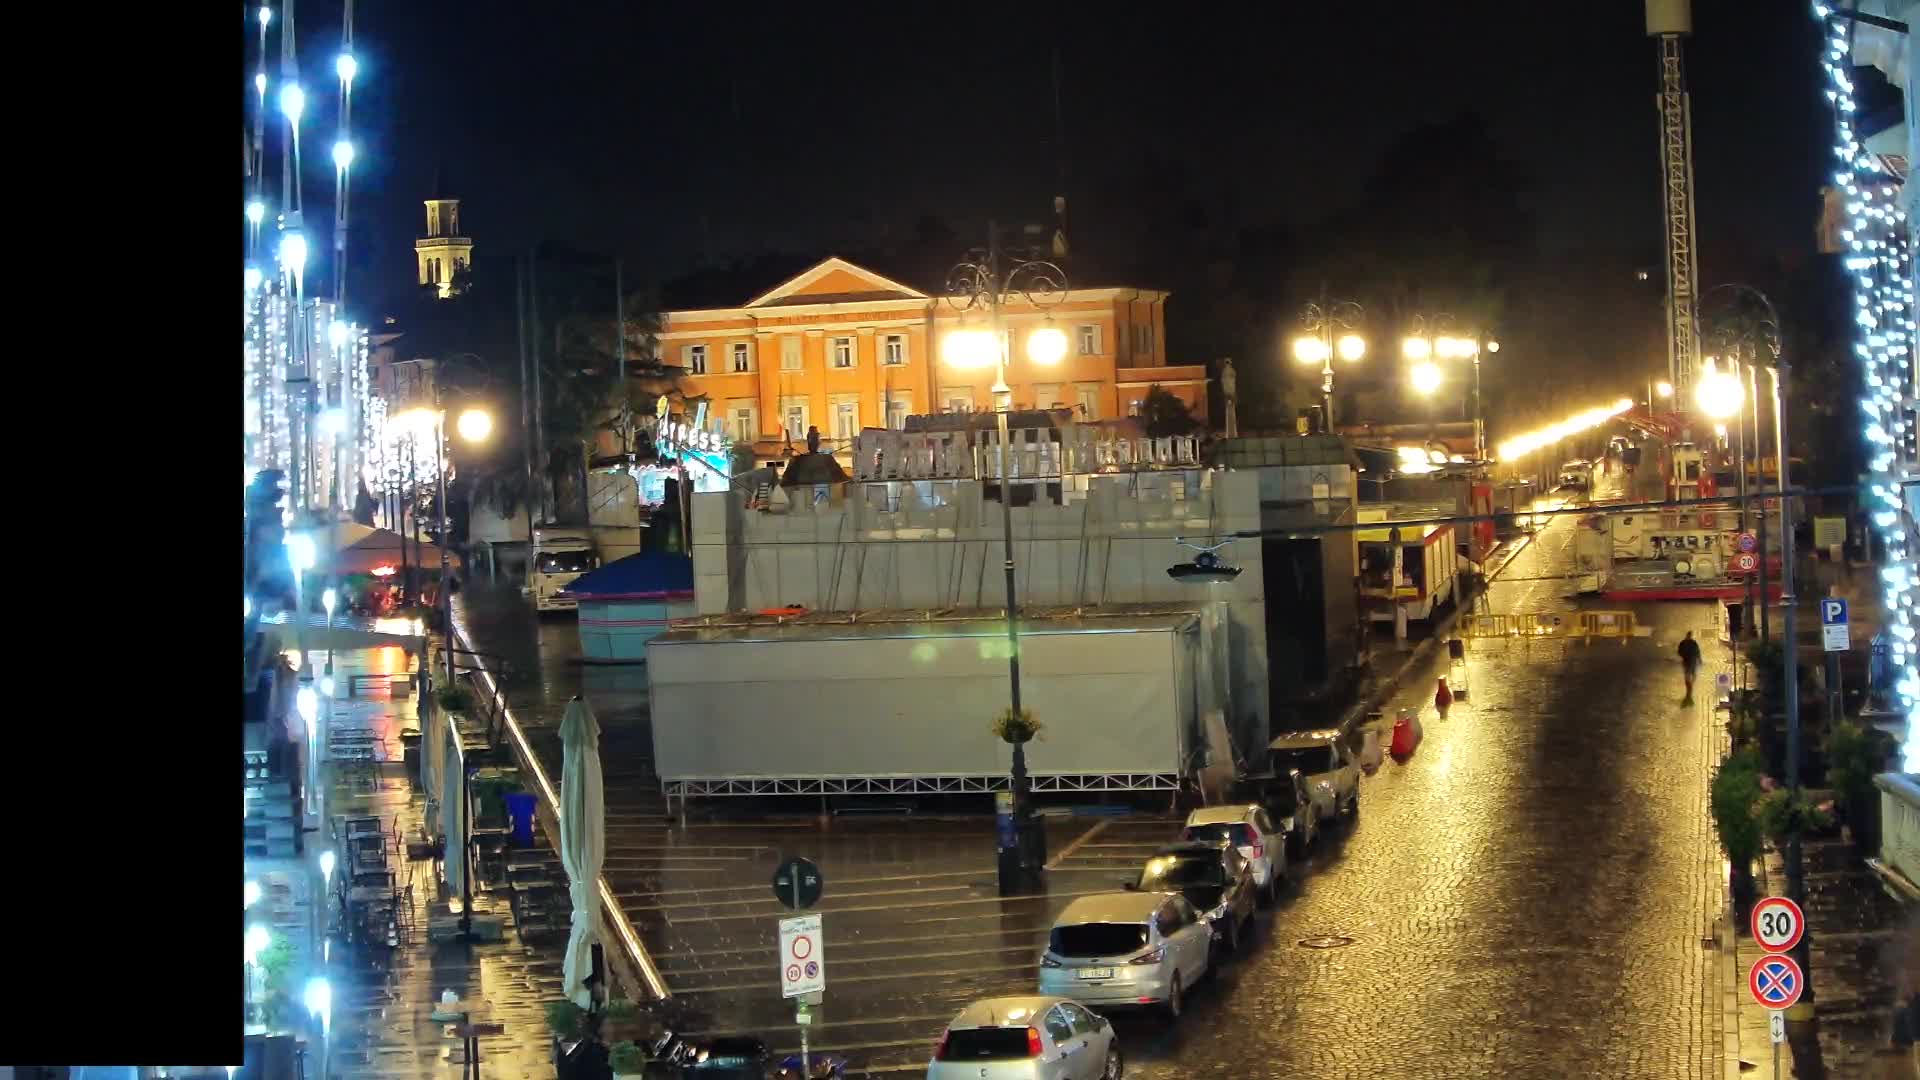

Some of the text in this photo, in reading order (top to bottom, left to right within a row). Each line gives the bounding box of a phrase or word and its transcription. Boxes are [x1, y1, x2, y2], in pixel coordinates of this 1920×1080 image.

[1741, 557, 1752, 567] 20
[1827, 602, 1842, 622] P
[1762, 912, 1791, 937] 30
